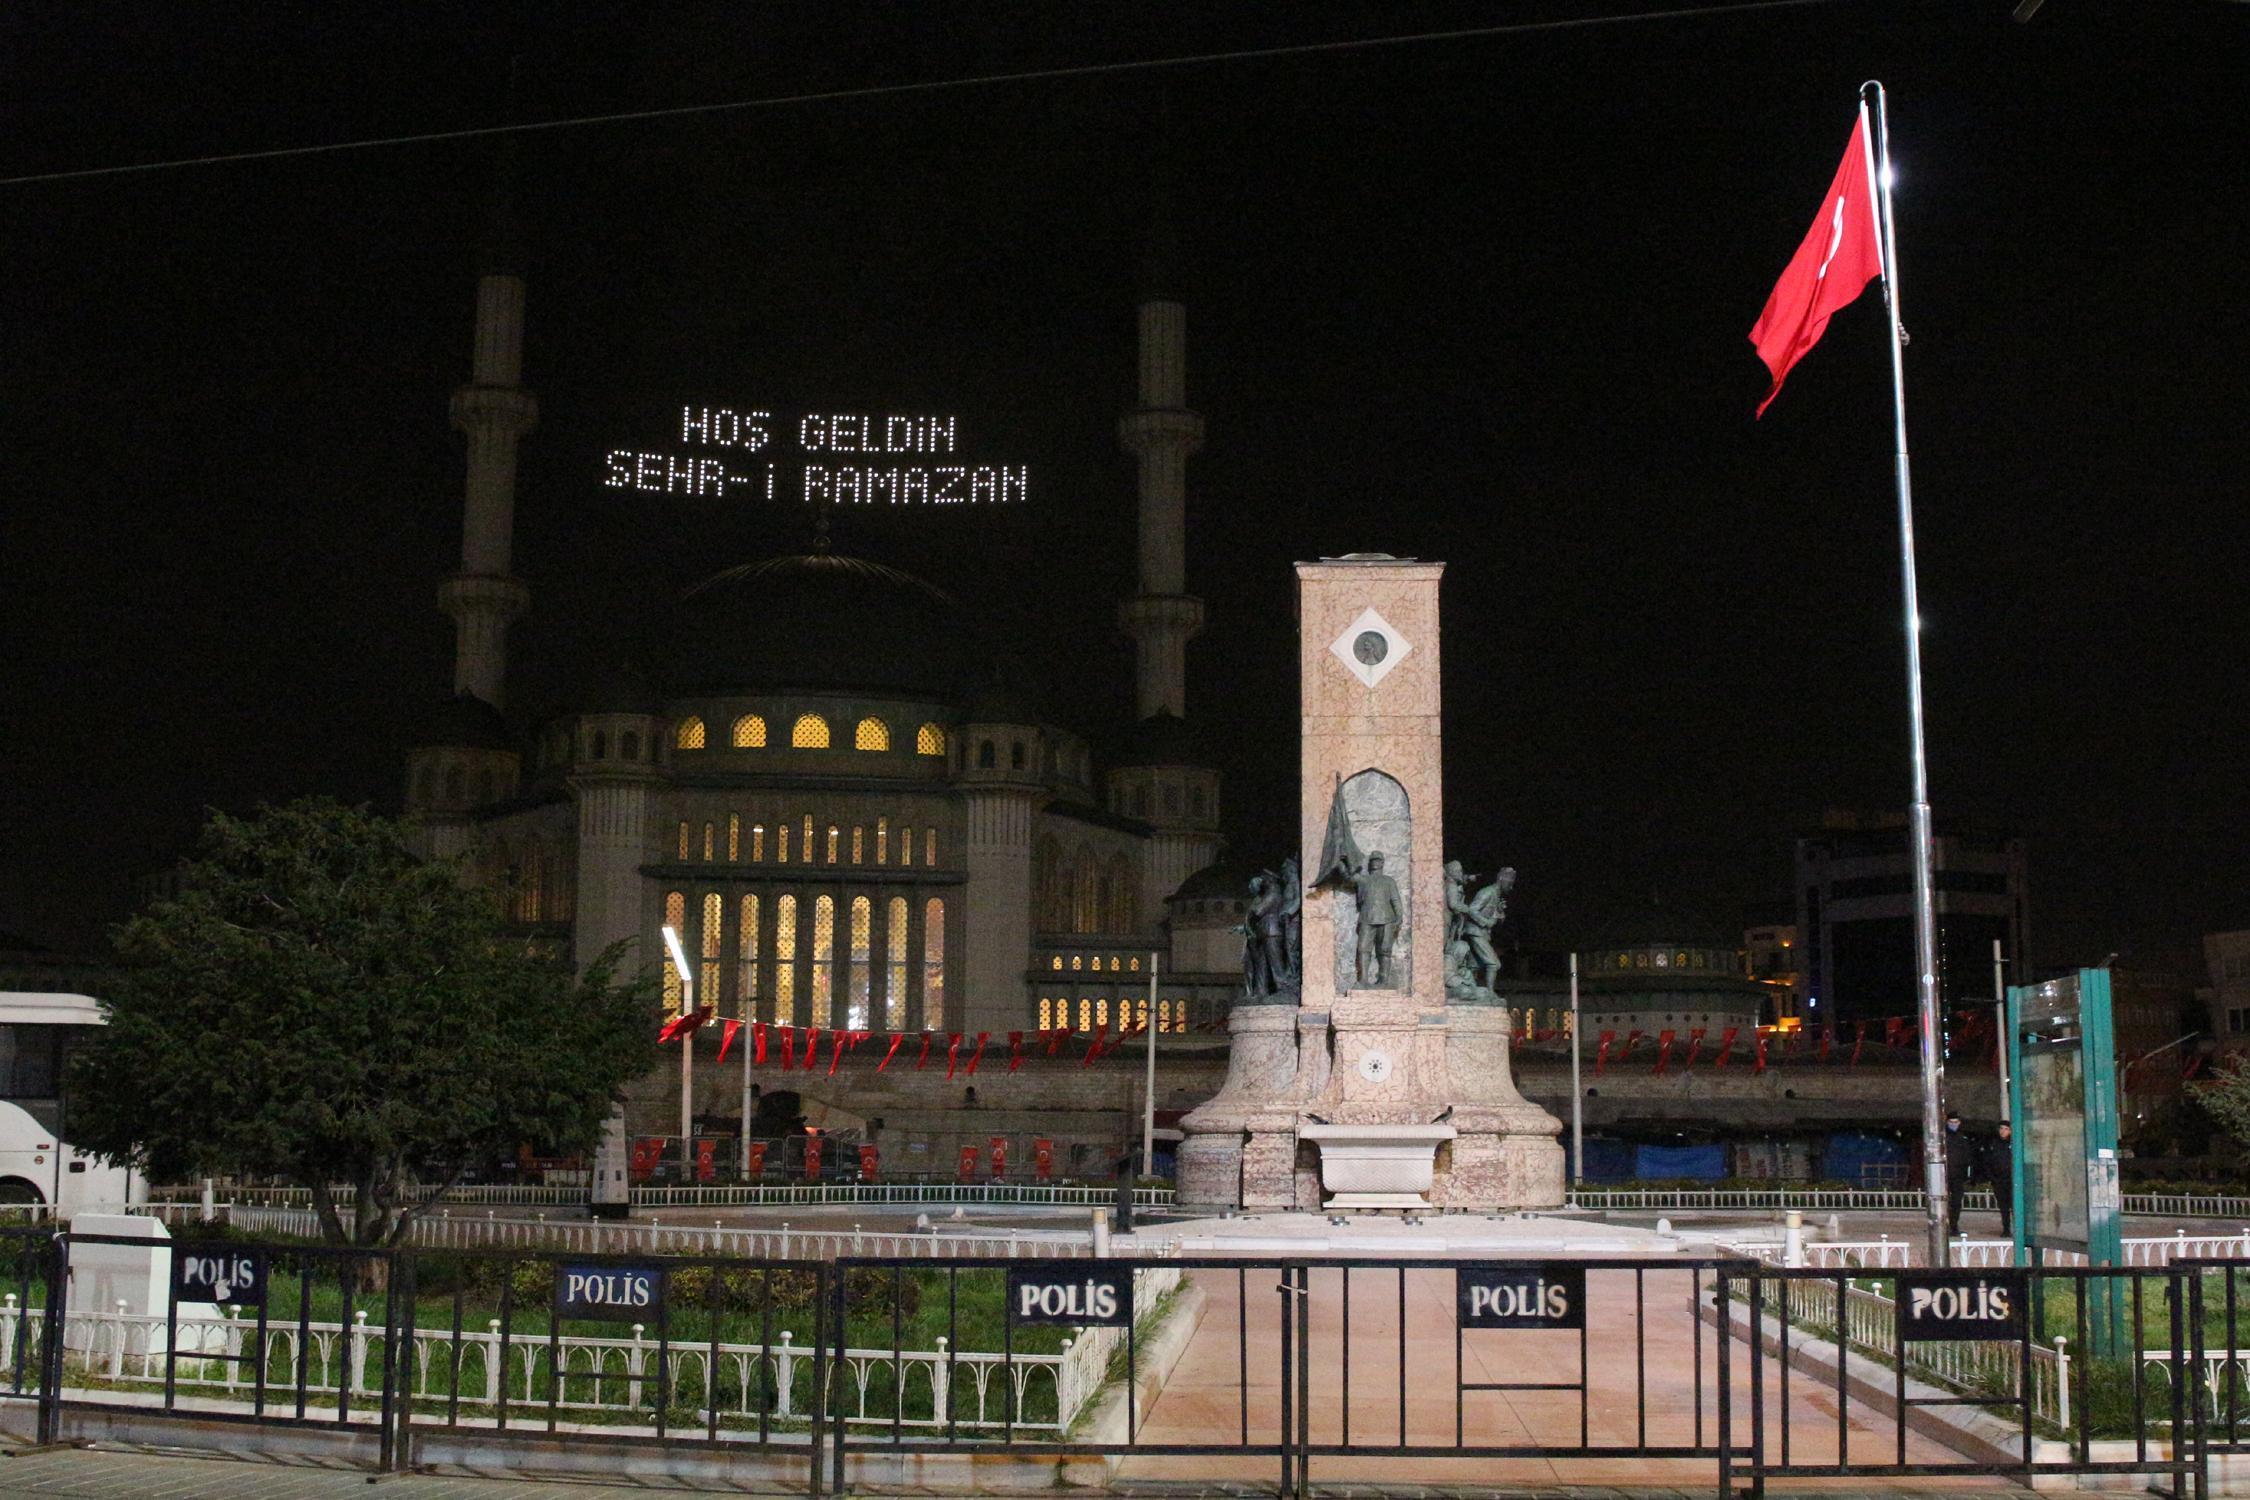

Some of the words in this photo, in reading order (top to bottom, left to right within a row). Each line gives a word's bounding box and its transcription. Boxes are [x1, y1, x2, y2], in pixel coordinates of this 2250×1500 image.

[683, 405, 770, 453] HOŞ
[800, 413, 956, 453] GELDİN
[804, 464, 1028, 504] RAMAZAN
[183, 1252, 254, 1290] POLİS
[566, 1272, 649, 1307] POLİS
[1020, 1278, 1117, 1318] POLİS
[1470, 1278, 1568, 1318] POLİS
[1910, 1280, 2010, 1321] POLİS
